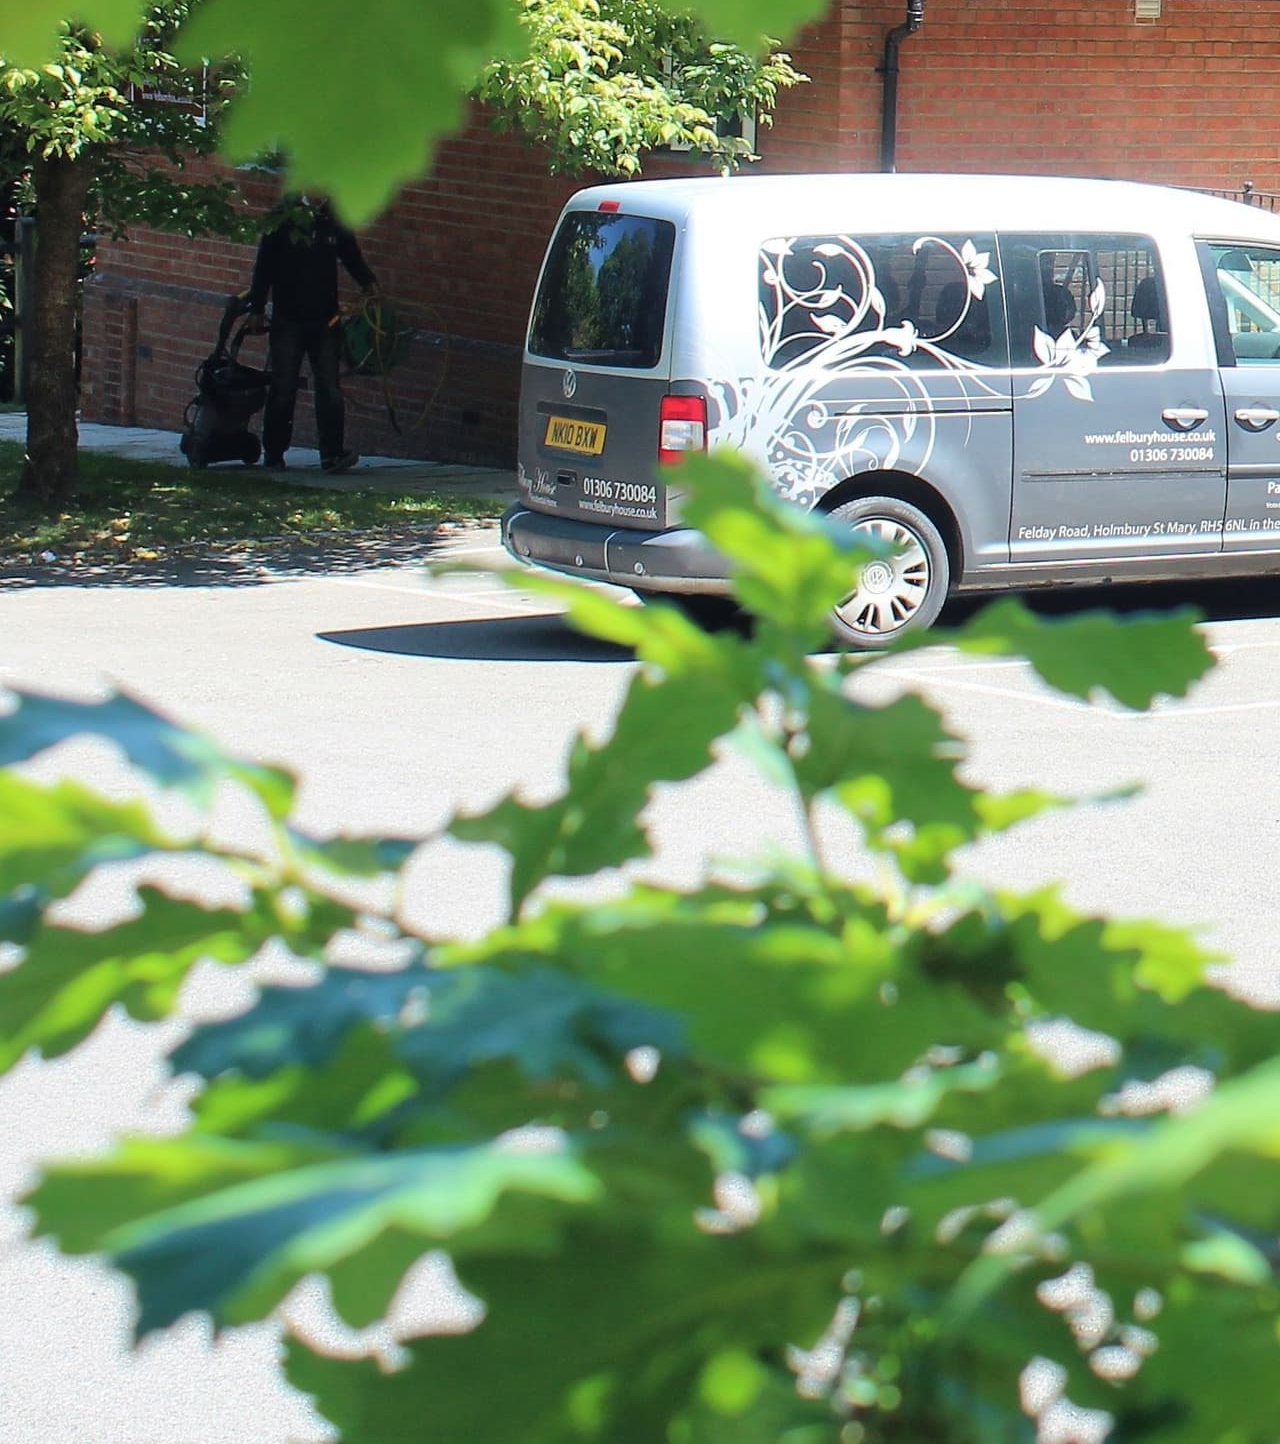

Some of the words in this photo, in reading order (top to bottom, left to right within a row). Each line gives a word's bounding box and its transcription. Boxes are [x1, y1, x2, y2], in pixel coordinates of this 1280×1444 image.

[1085, 430, 1216, 445] www.felburyhouse.co.uk
[1130, 449, 1168, 462] 01306
[1170, 447, 1214, 461] 730084
[583, 477, 612, 498] 01306
[613, 482, 657, 504] 730084
[1018, 525, 1056, 541] Felday
[1058, 524, 1090, 539] Road,
[1093, 522, 1151, 538] Holmbury
[1153, 521, 1165, 534] St
[1167, 521, 1198, 536] Mary,
[1200, 520, 1223, 533] RH5
[1225, 519, 1247, 531] 6NL
[1249, 519, 1260, 531] in
[1262, 517, 1280, 530] the
